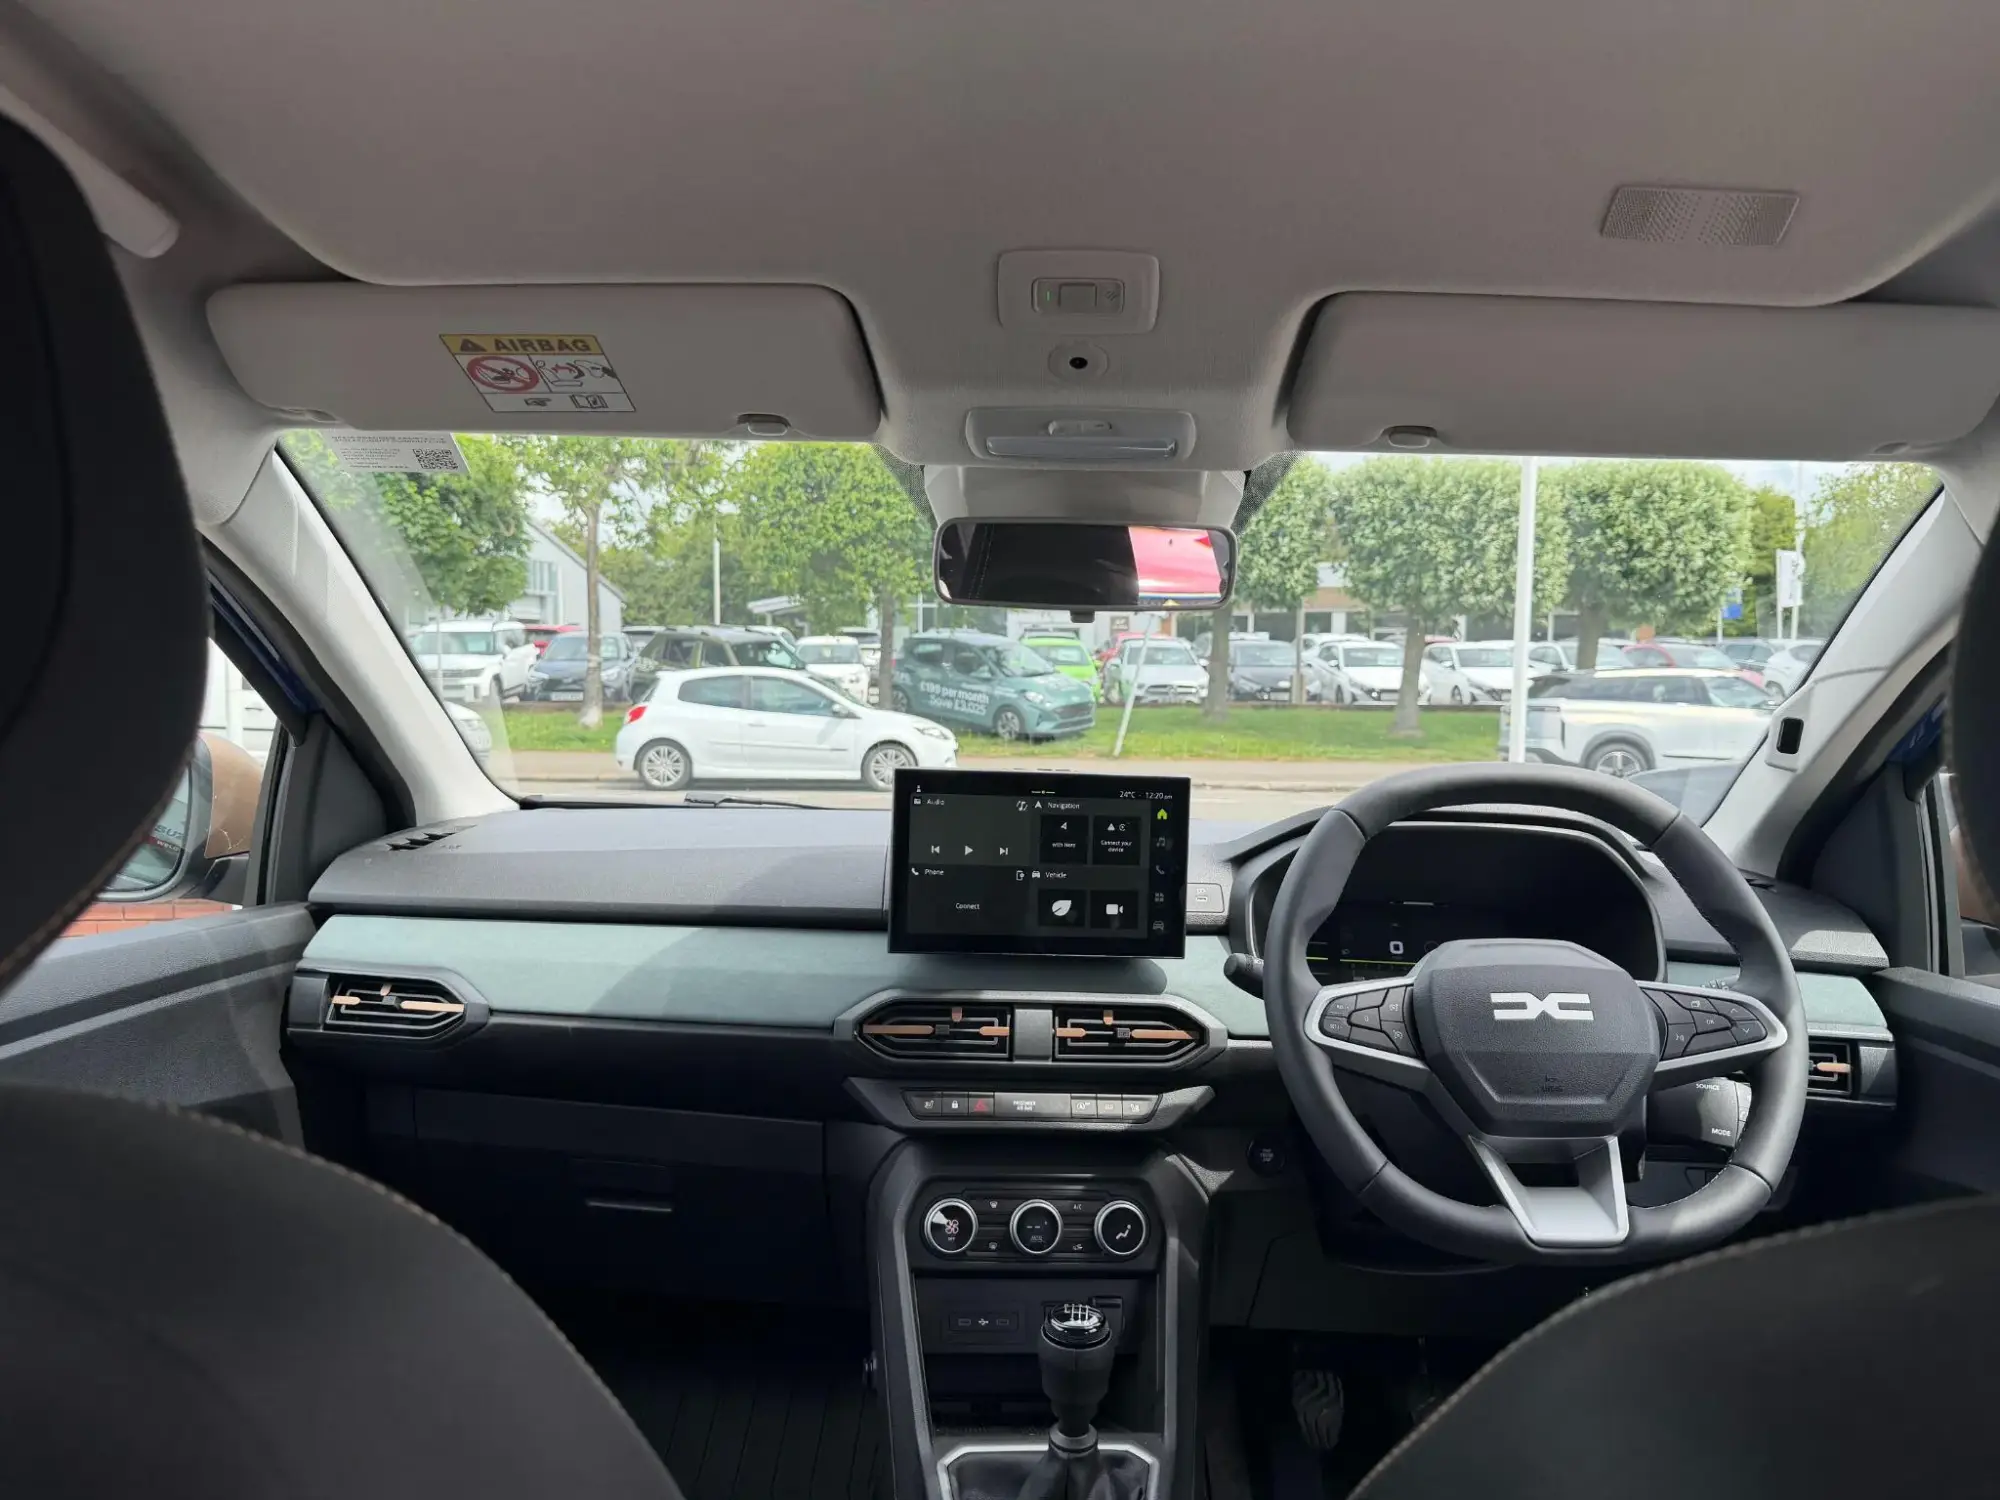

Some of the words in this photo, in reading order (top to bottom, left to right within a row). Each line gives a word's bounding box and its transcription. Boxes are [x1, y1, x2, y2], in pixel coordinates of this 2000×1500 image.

[494, 338, 591, 352] AIRBAG
[926, 798, 945, 806] Audio
[1047, 801, 1080, 810] Navigation
[924, 868, 945, 876] Phone
[1045, 871, 1067, 879] Vehicle
[955, 902, 981, 910] Connect
[1696, 1083, 1720, 1091] SOURCE
[1711, 1127, 1731, 1137] MODE
